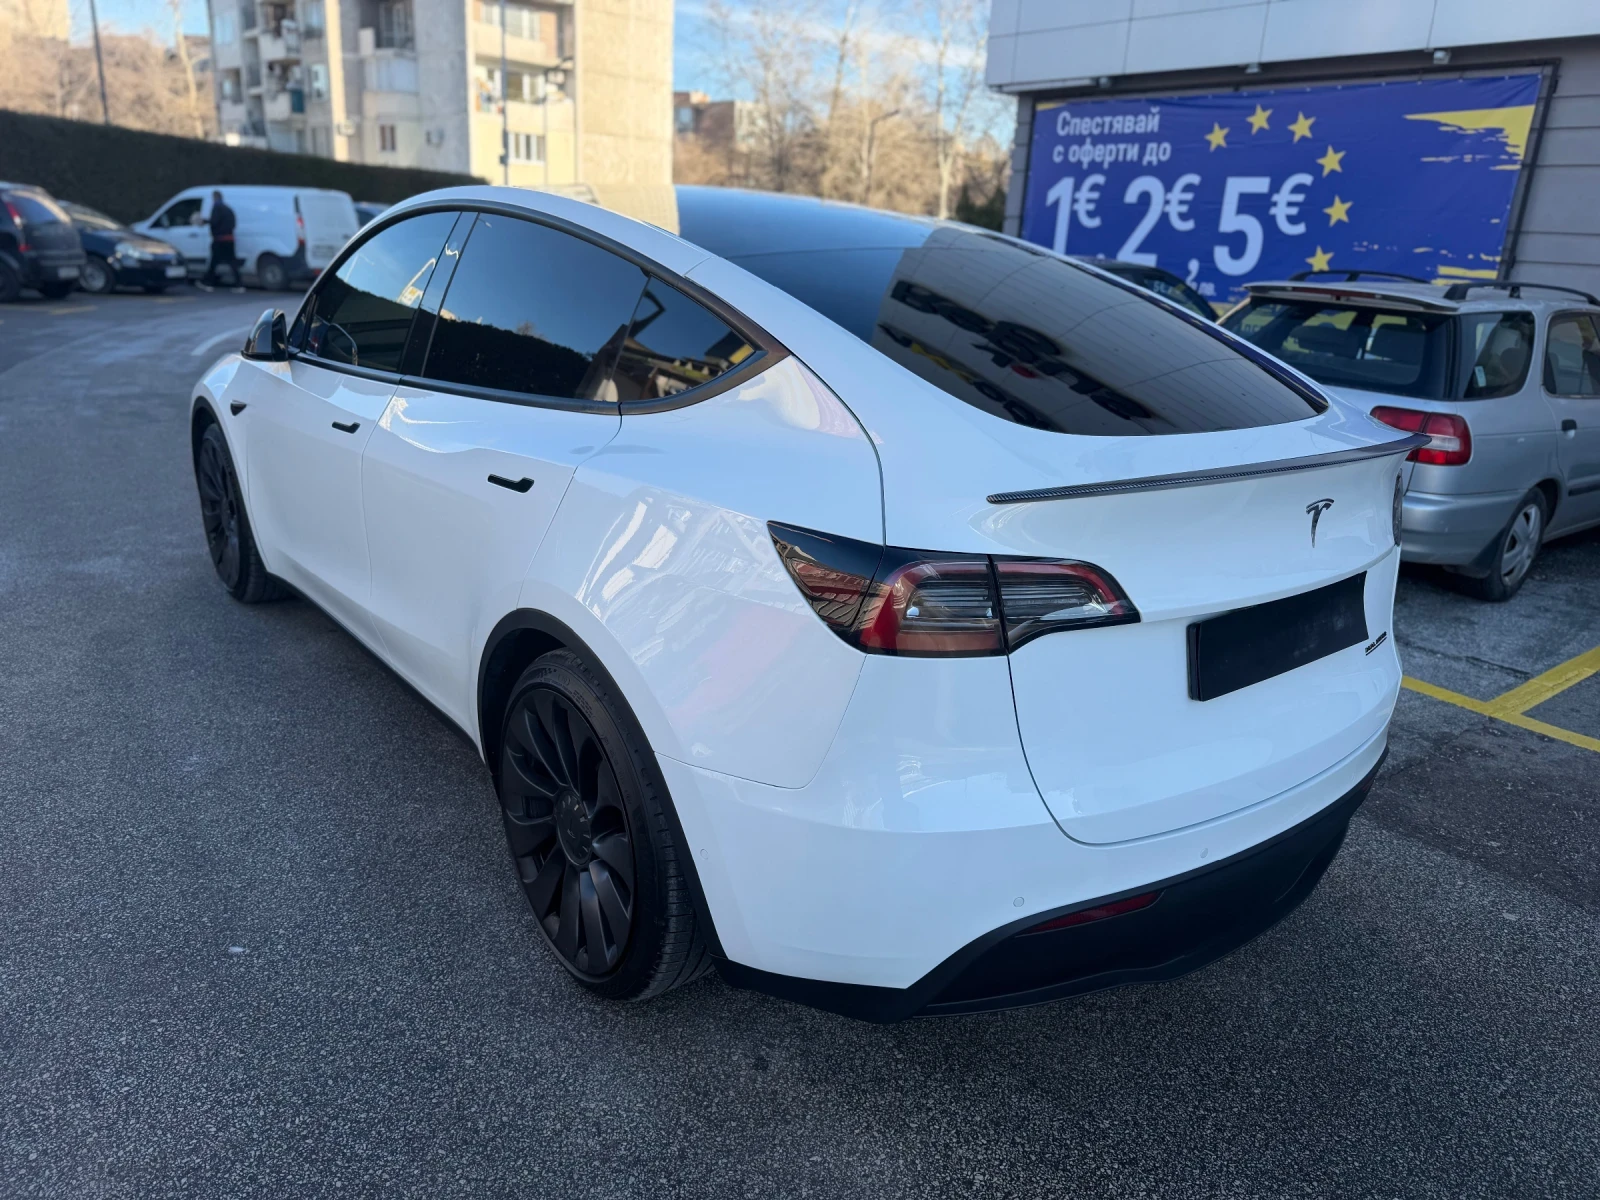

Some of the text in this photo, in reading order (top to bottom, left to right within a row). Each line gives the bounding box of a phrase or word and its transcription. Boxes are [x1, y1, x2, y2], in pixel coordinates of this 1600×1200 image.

[1056, 106, 1160, 136] Спестявай
[1052, 137, 1171, 169] с оферти до
[1213, 172, 1314, 276] 5€
